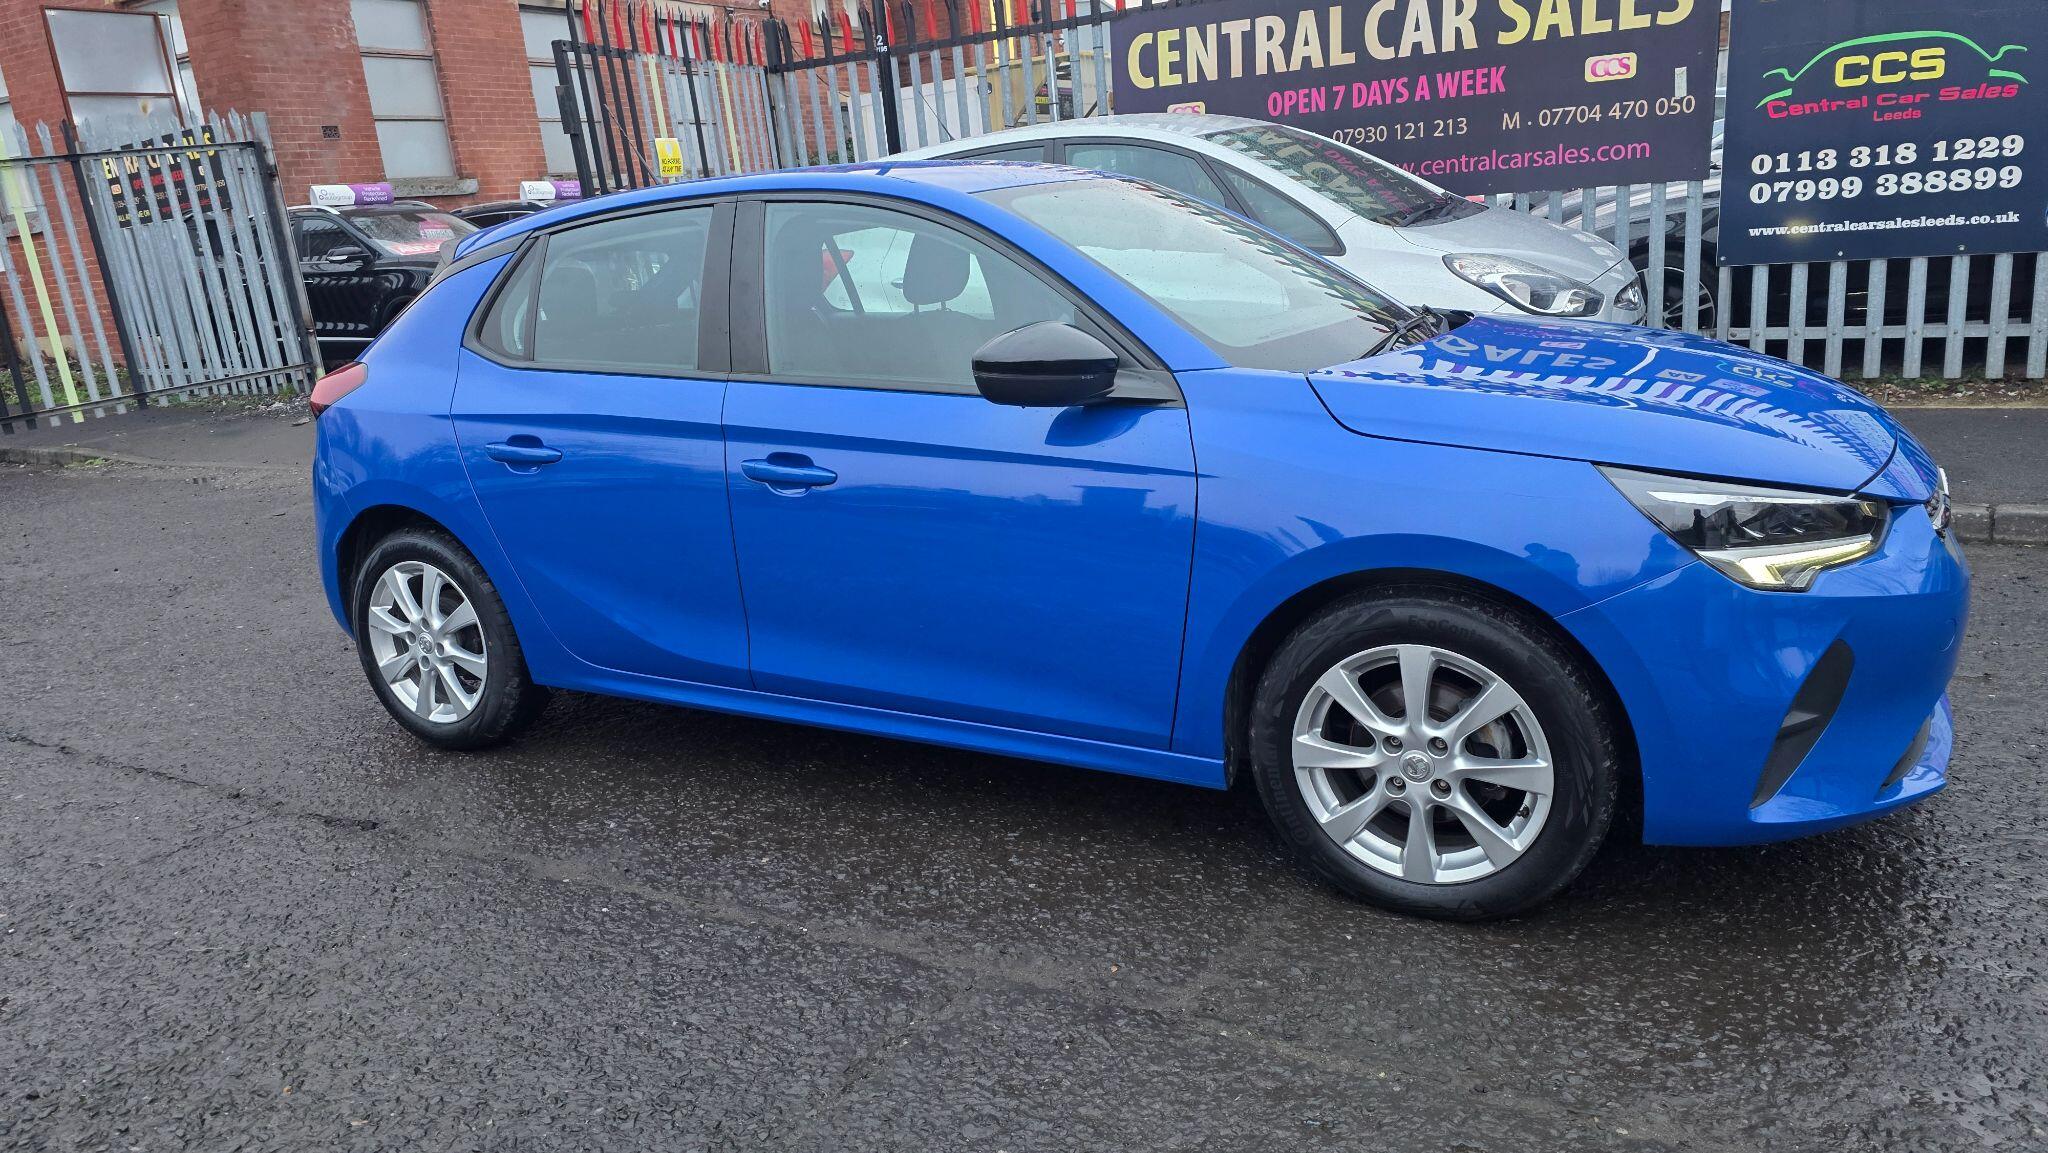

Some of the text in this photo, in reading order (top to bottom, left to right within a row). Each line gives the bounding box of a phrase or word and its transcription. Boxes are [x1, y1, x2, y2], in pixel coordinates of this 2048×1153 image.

[1127, 6, 1356, 90] CENTRAL
[1364, 0, 1478, 60] CAR
[1590, 56, 1631, 78] CCS
[1835, 47, 1946, 88] CCS
[1267, 65, 1507, 117] OPEN 7 DAYS A WEEK
[1767, 82, 2019, 119] Central Car Sales
[1332, 125, 1387, 145] 07930
[1395, 121, 1425, 141] 121
[1433, 117, 1469, 137] 213
[1502, 111, 1521, 130] M
[1538, 105, 1601, 127] 07704
[1608, 100, 1649, 121] 470
[1655, 95, 1696, 116] 050
[1873, 108, 1922, 122] Leeds
[1393, 142, 1650, 178] w.centralcarsales.com
[1750, 134, 2025, 175] 0113 318 1229
[1749, 165, 2023, 205] 07999 388899
[1748, 210, 2020, 237] www.centralcarsalesleeds.co.uk
